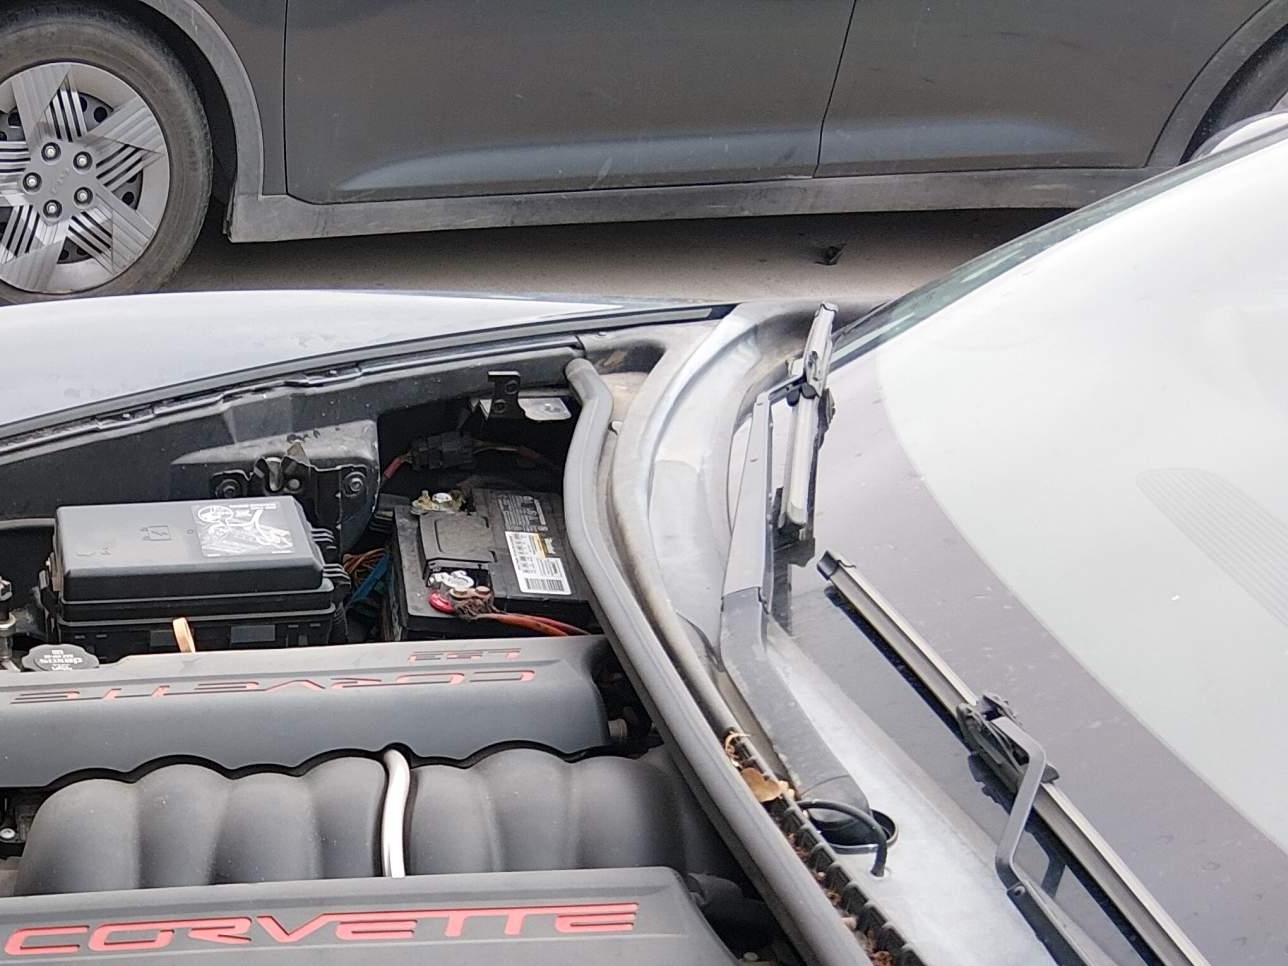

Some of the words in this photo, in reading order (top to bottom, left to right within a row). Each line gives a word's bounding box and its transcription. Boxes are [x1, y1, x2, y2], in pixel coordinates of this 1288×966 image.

[409, 648, 521, 661] LS3
[11, 670, 536, 703] CORVETTE
[5, 903, 638, 956] CORVETTE
